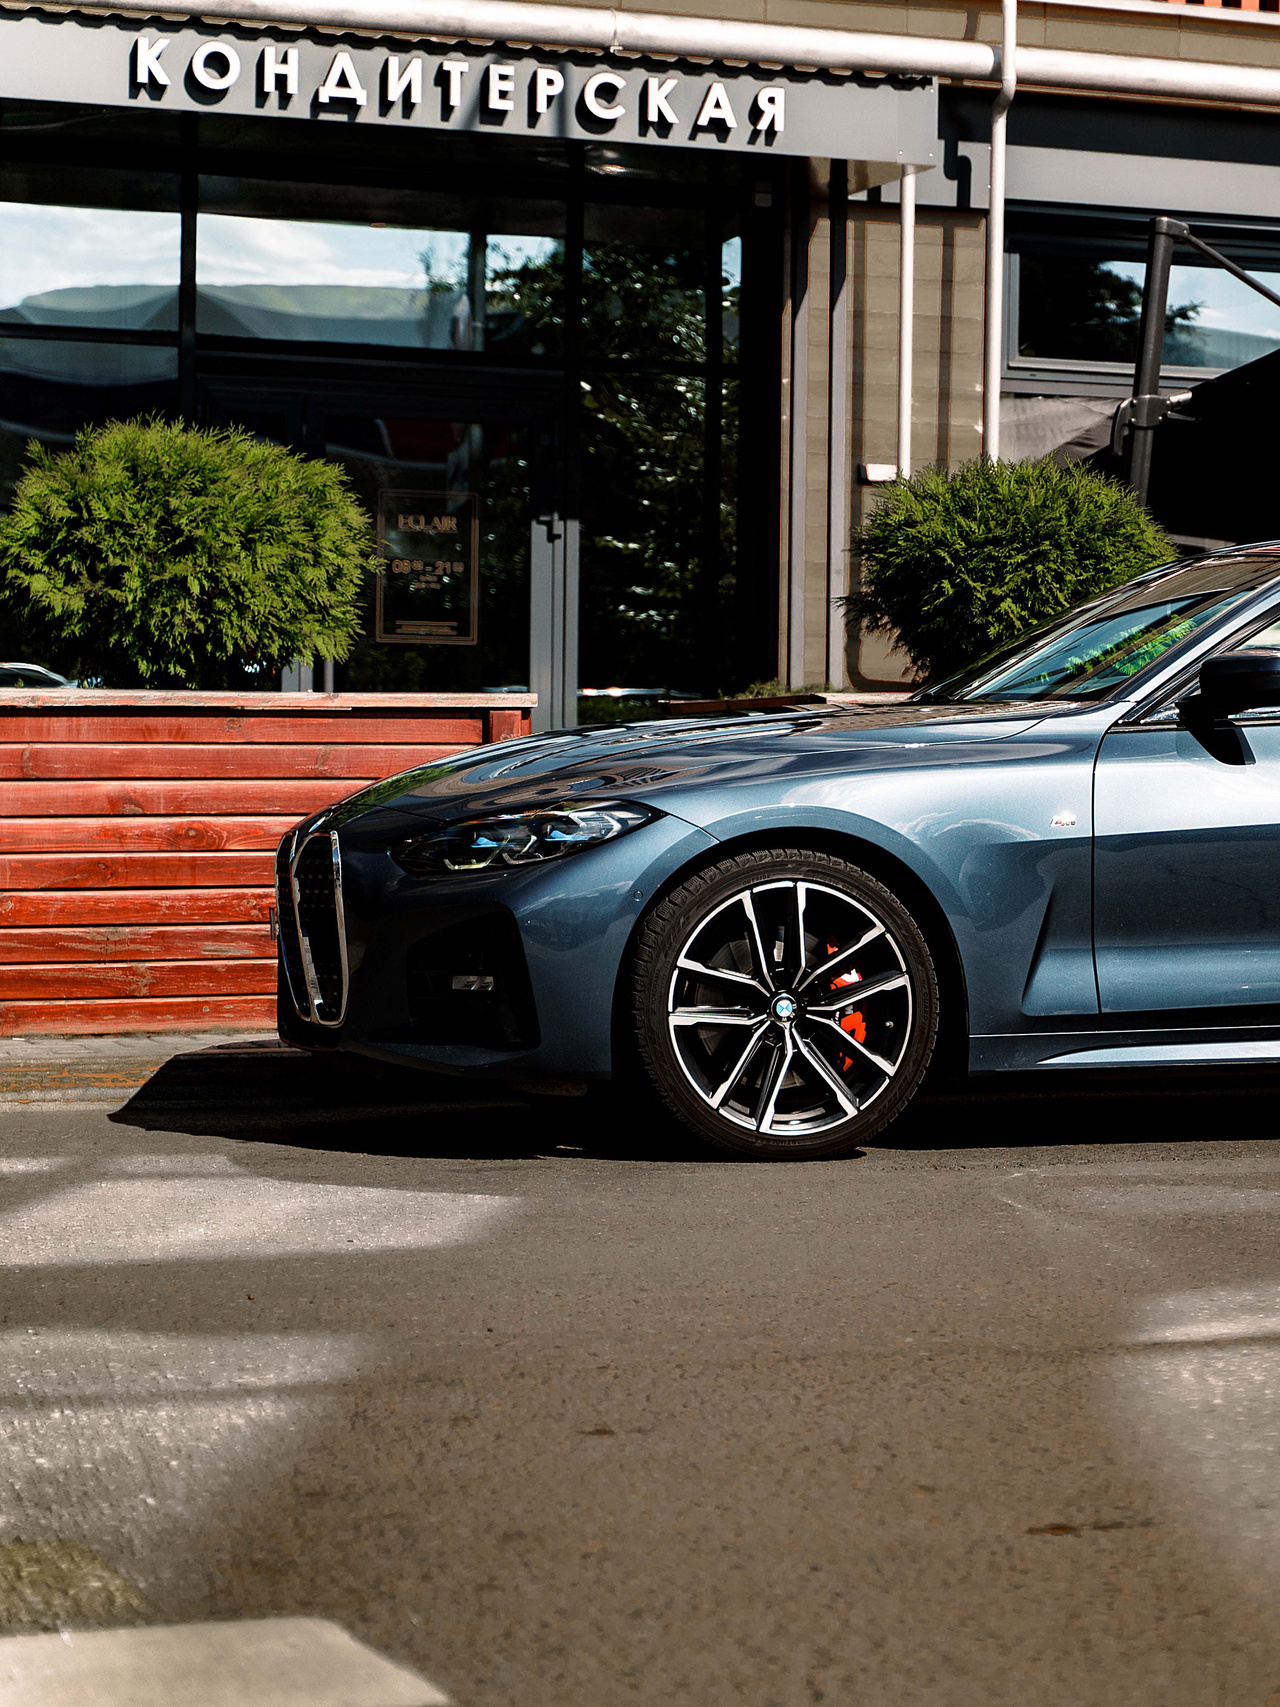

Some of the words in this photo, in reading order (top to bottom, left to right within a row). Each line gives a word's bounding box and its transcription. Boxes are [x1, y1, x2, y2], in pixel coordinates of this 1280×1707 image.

[134, 35, 786, 133] КОНДИТЕРСКАЯ
[397, 513, 458, 532] ECLAIR
[650, 968, 662, 1005] YOKOHAMA
